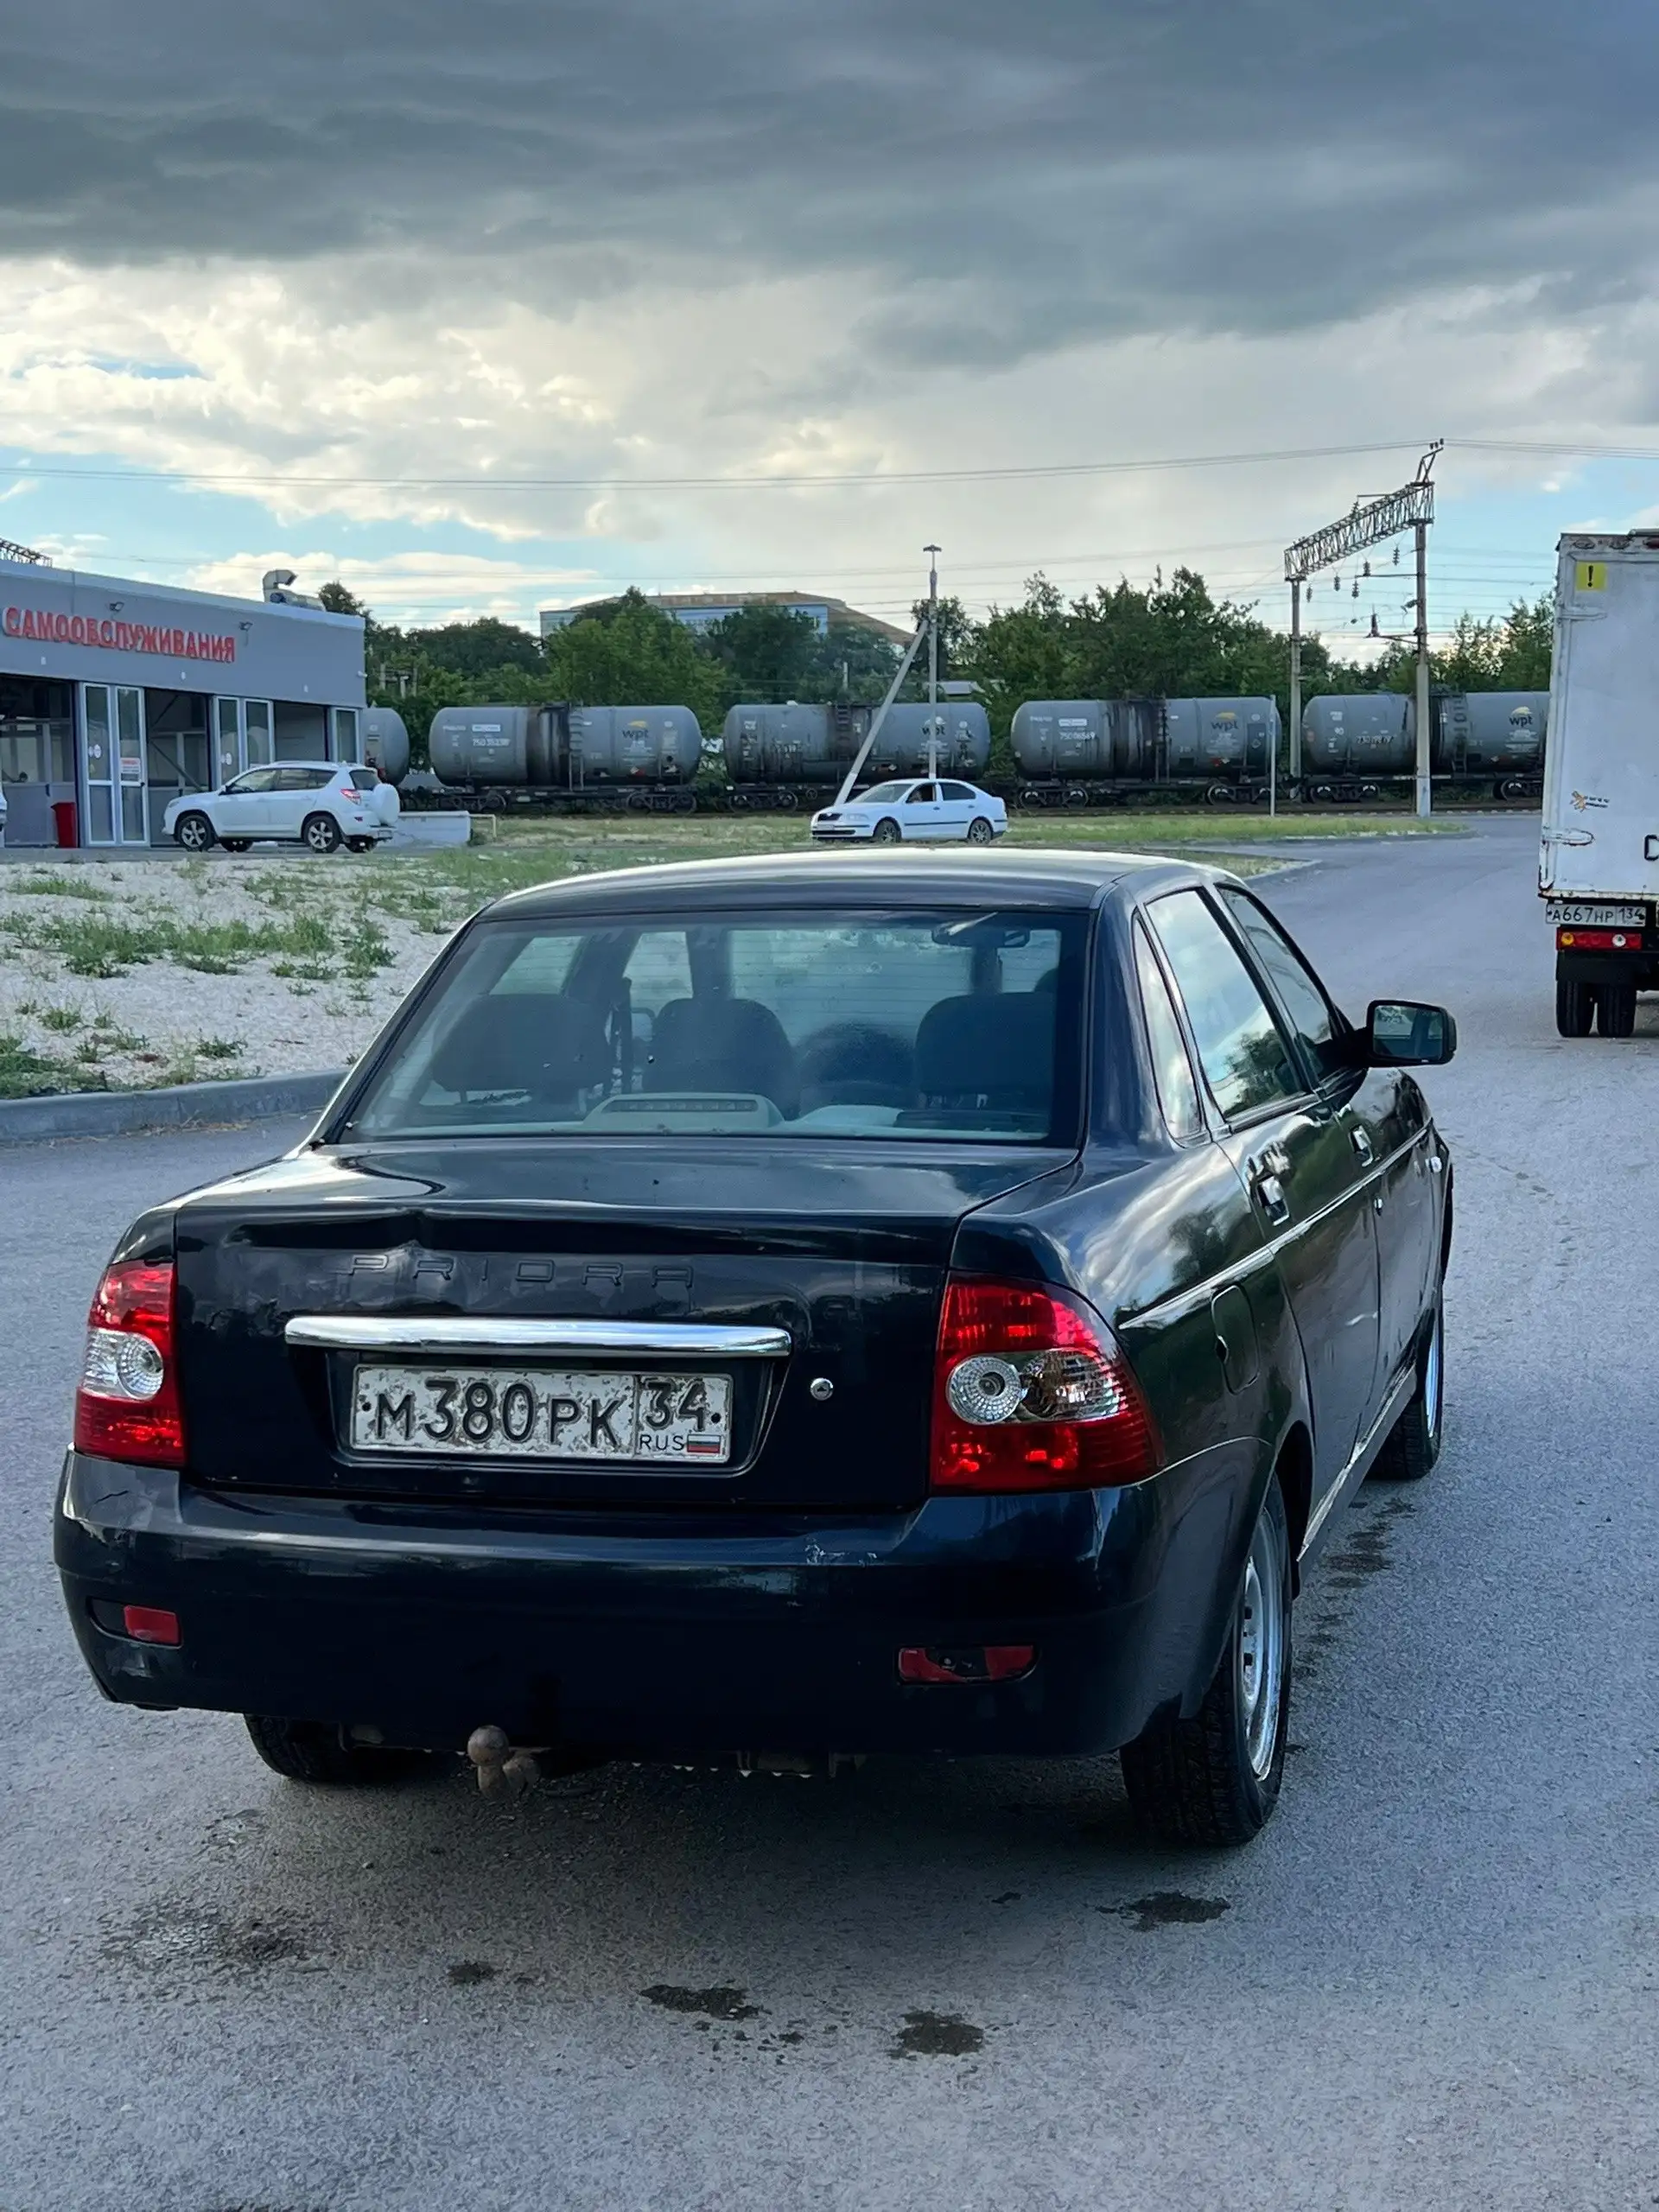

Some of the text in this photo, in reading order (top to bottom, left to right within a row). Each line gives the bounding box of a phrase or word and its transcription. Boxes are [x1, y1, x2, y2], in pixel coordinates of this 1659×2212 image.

[3, 607, 235, 663] САМООБСЛУЖИВАНИЯ
[1508, 715, 1533, 727] wpt
[622, 729, 649, 741] wpt
[348, 1254, 692, 1289] PRIORA
[640, 1381, 706, 1431] 34
[639, 1433, 684, 1452] RUS
